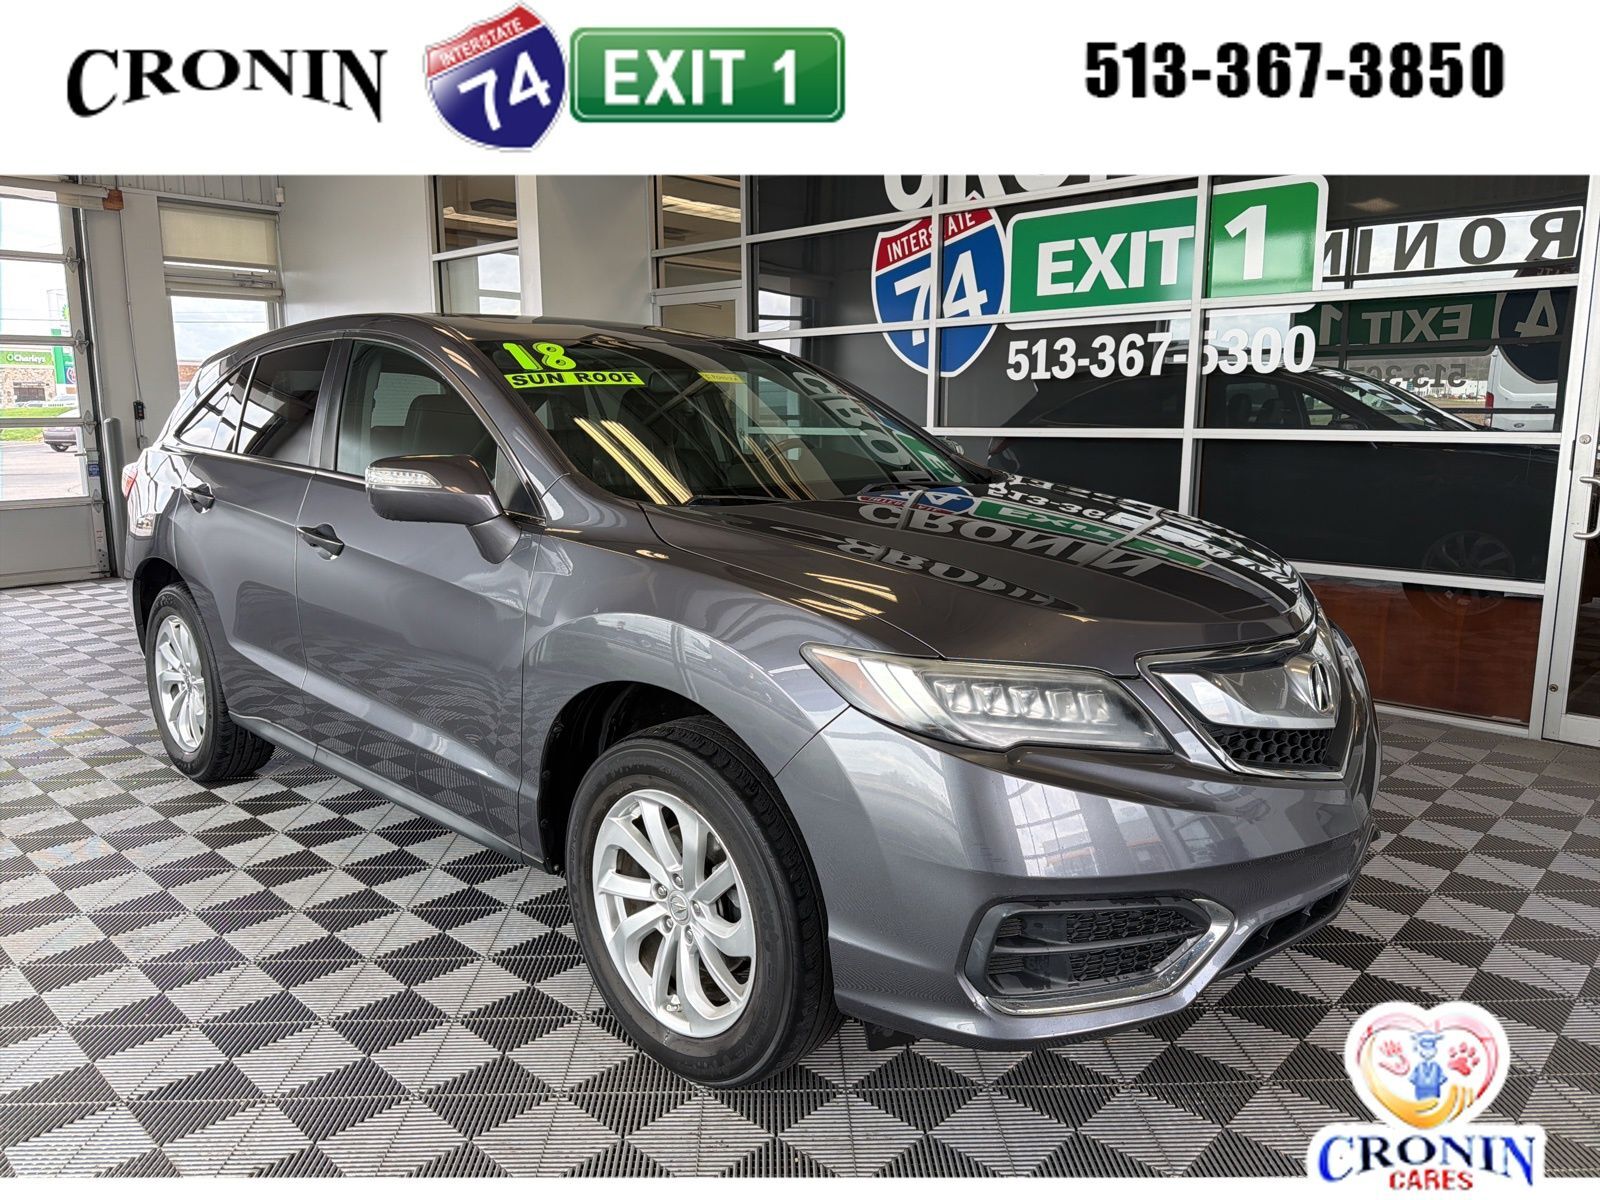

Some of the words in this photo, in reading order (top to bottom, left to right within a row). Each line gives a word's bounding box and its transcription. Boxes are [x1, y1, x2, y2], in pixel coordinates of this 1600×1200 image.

[886, 210, 976, 263] INTERATE
[1036, 225, 1195, 297] EXIT
[1223, 204, 1267, 281] 1
[893, 250, 988, 346] 74
[502, 341, 577, 371] 18
[511, 373, 565, 386] SUN
[574, 372, 637, 384] ROOF
[1005, 324, 1316, 381] 513-367-5300
